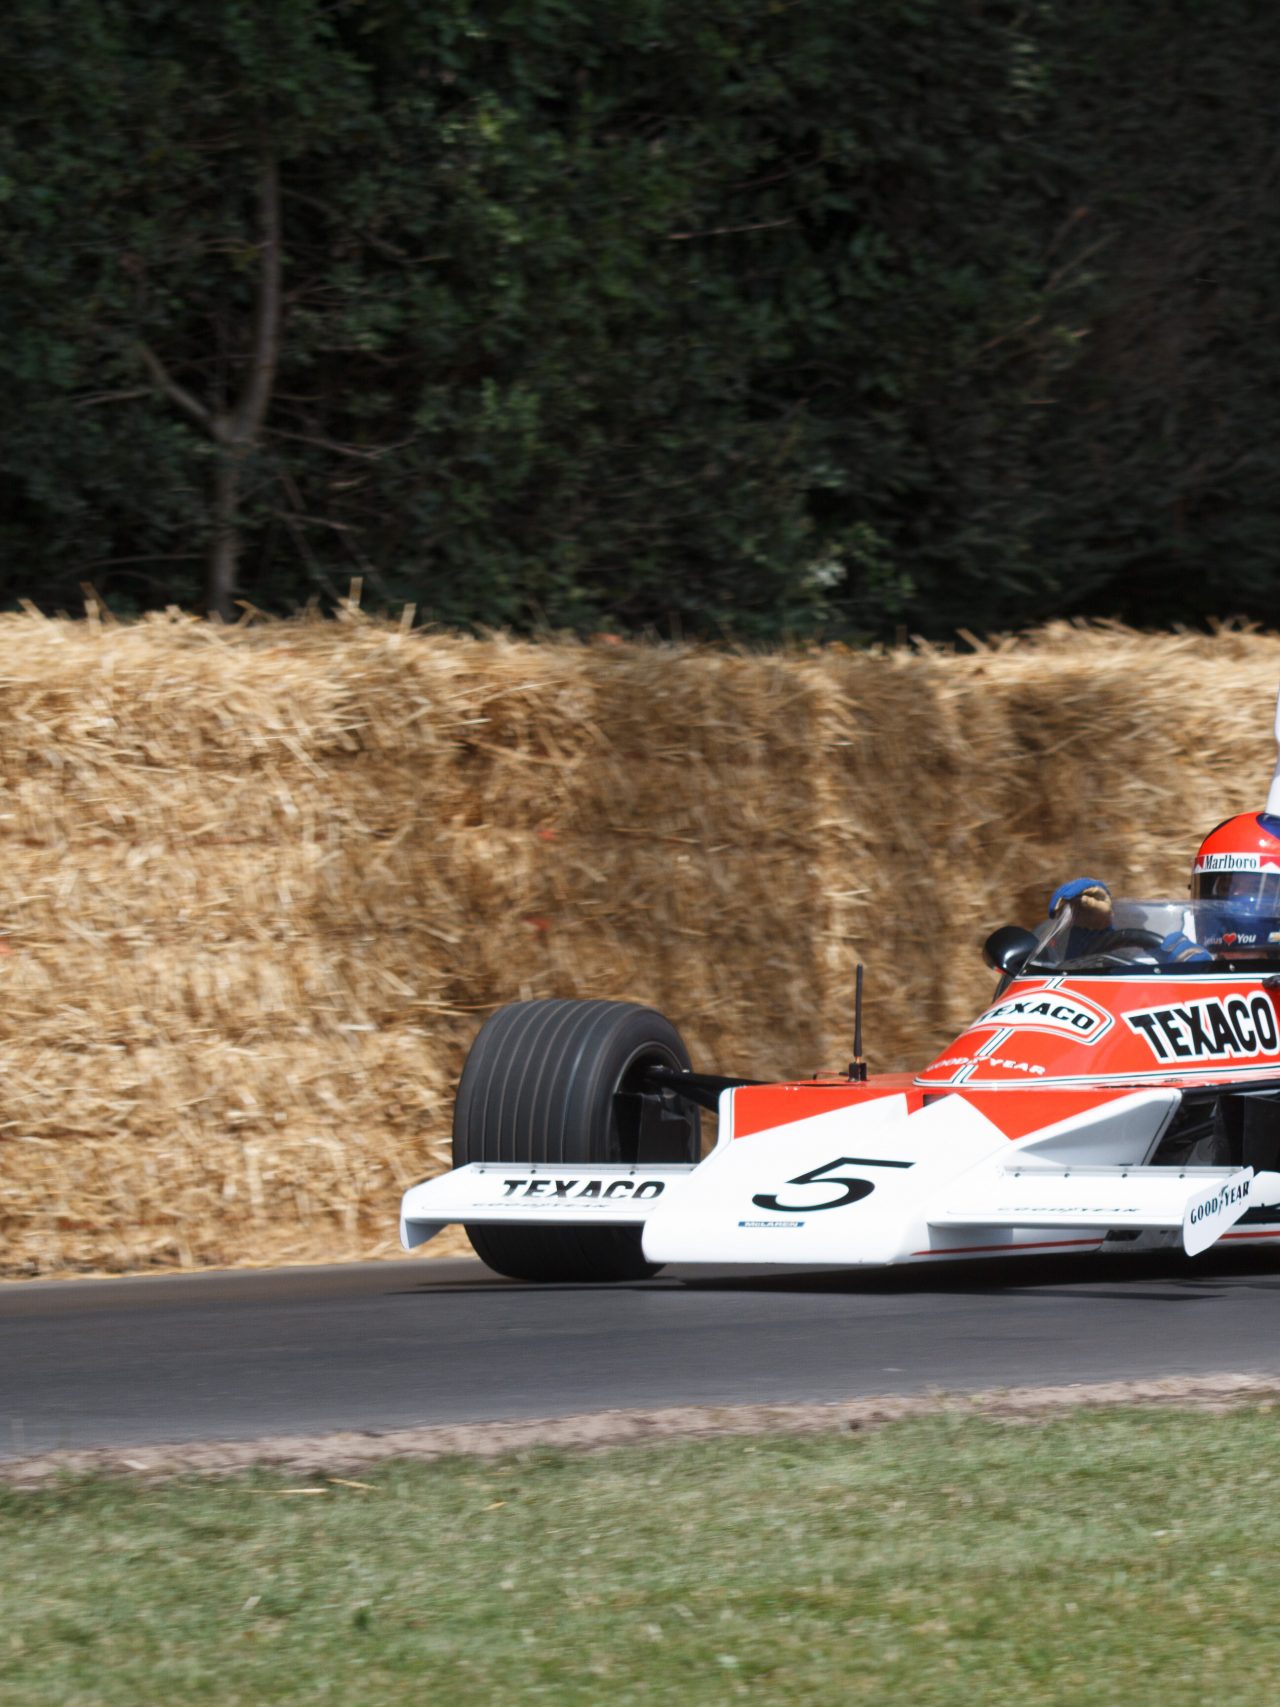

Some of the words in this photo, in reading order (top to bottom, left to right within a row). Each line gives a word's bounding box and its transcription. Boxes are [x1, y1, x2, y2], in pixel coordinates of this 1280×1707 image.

[1205, 854, 1257, 870] Marlboro
[1237, 933, 1257, 944] You
[977, 1001, 1095, 1030] TEXACO
[1128, 997, 1278, 1058] TEXACO
[502, 1179, 666, 1200] TEXACO
[752, 1156, 917, 1213] 5
